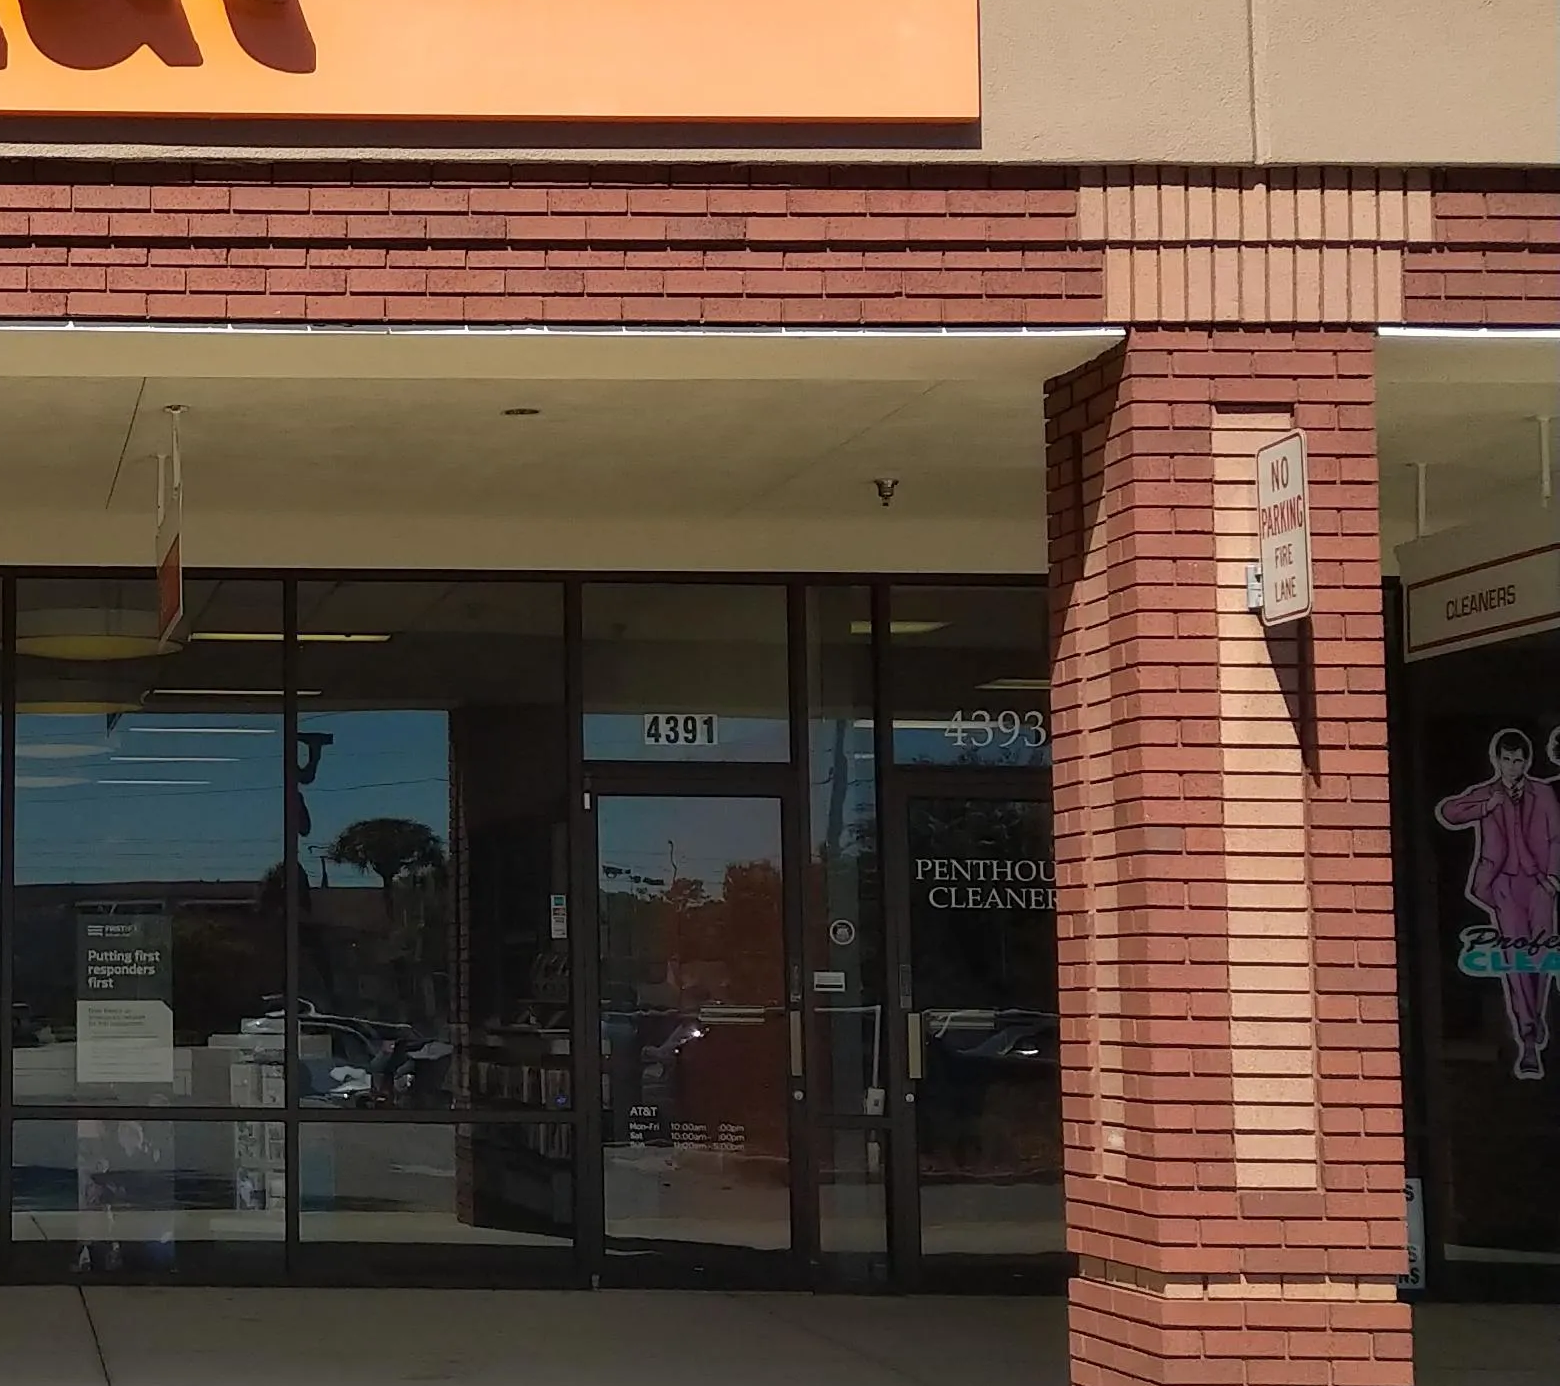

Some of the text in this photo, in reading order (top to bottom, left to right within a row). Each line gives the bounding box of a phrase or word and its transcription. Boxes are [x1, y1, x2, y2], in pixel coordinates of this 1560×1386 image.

[1270, 455, 1290, 493] NO
[1261, 493, 1304, 541] PARKING
[1274, 542, 1294, 570] FIRE
[1274, 575, 1298, 604] LANE
[1445, 584, 1516, 621] CLEANERS
[646, 715, 714, 744] 4391
[943, 709, 1048, 748] 4393
[87, 949, 161, 964] Putting first
[87, 963, 157, 977] responders
[87, 976, 115, 989] first
[629, 1106, 659, 1117] AT&T
[629, 1122, 660, 1131] Mon-Fri
[630, 1132, 644, 1140] Sat
